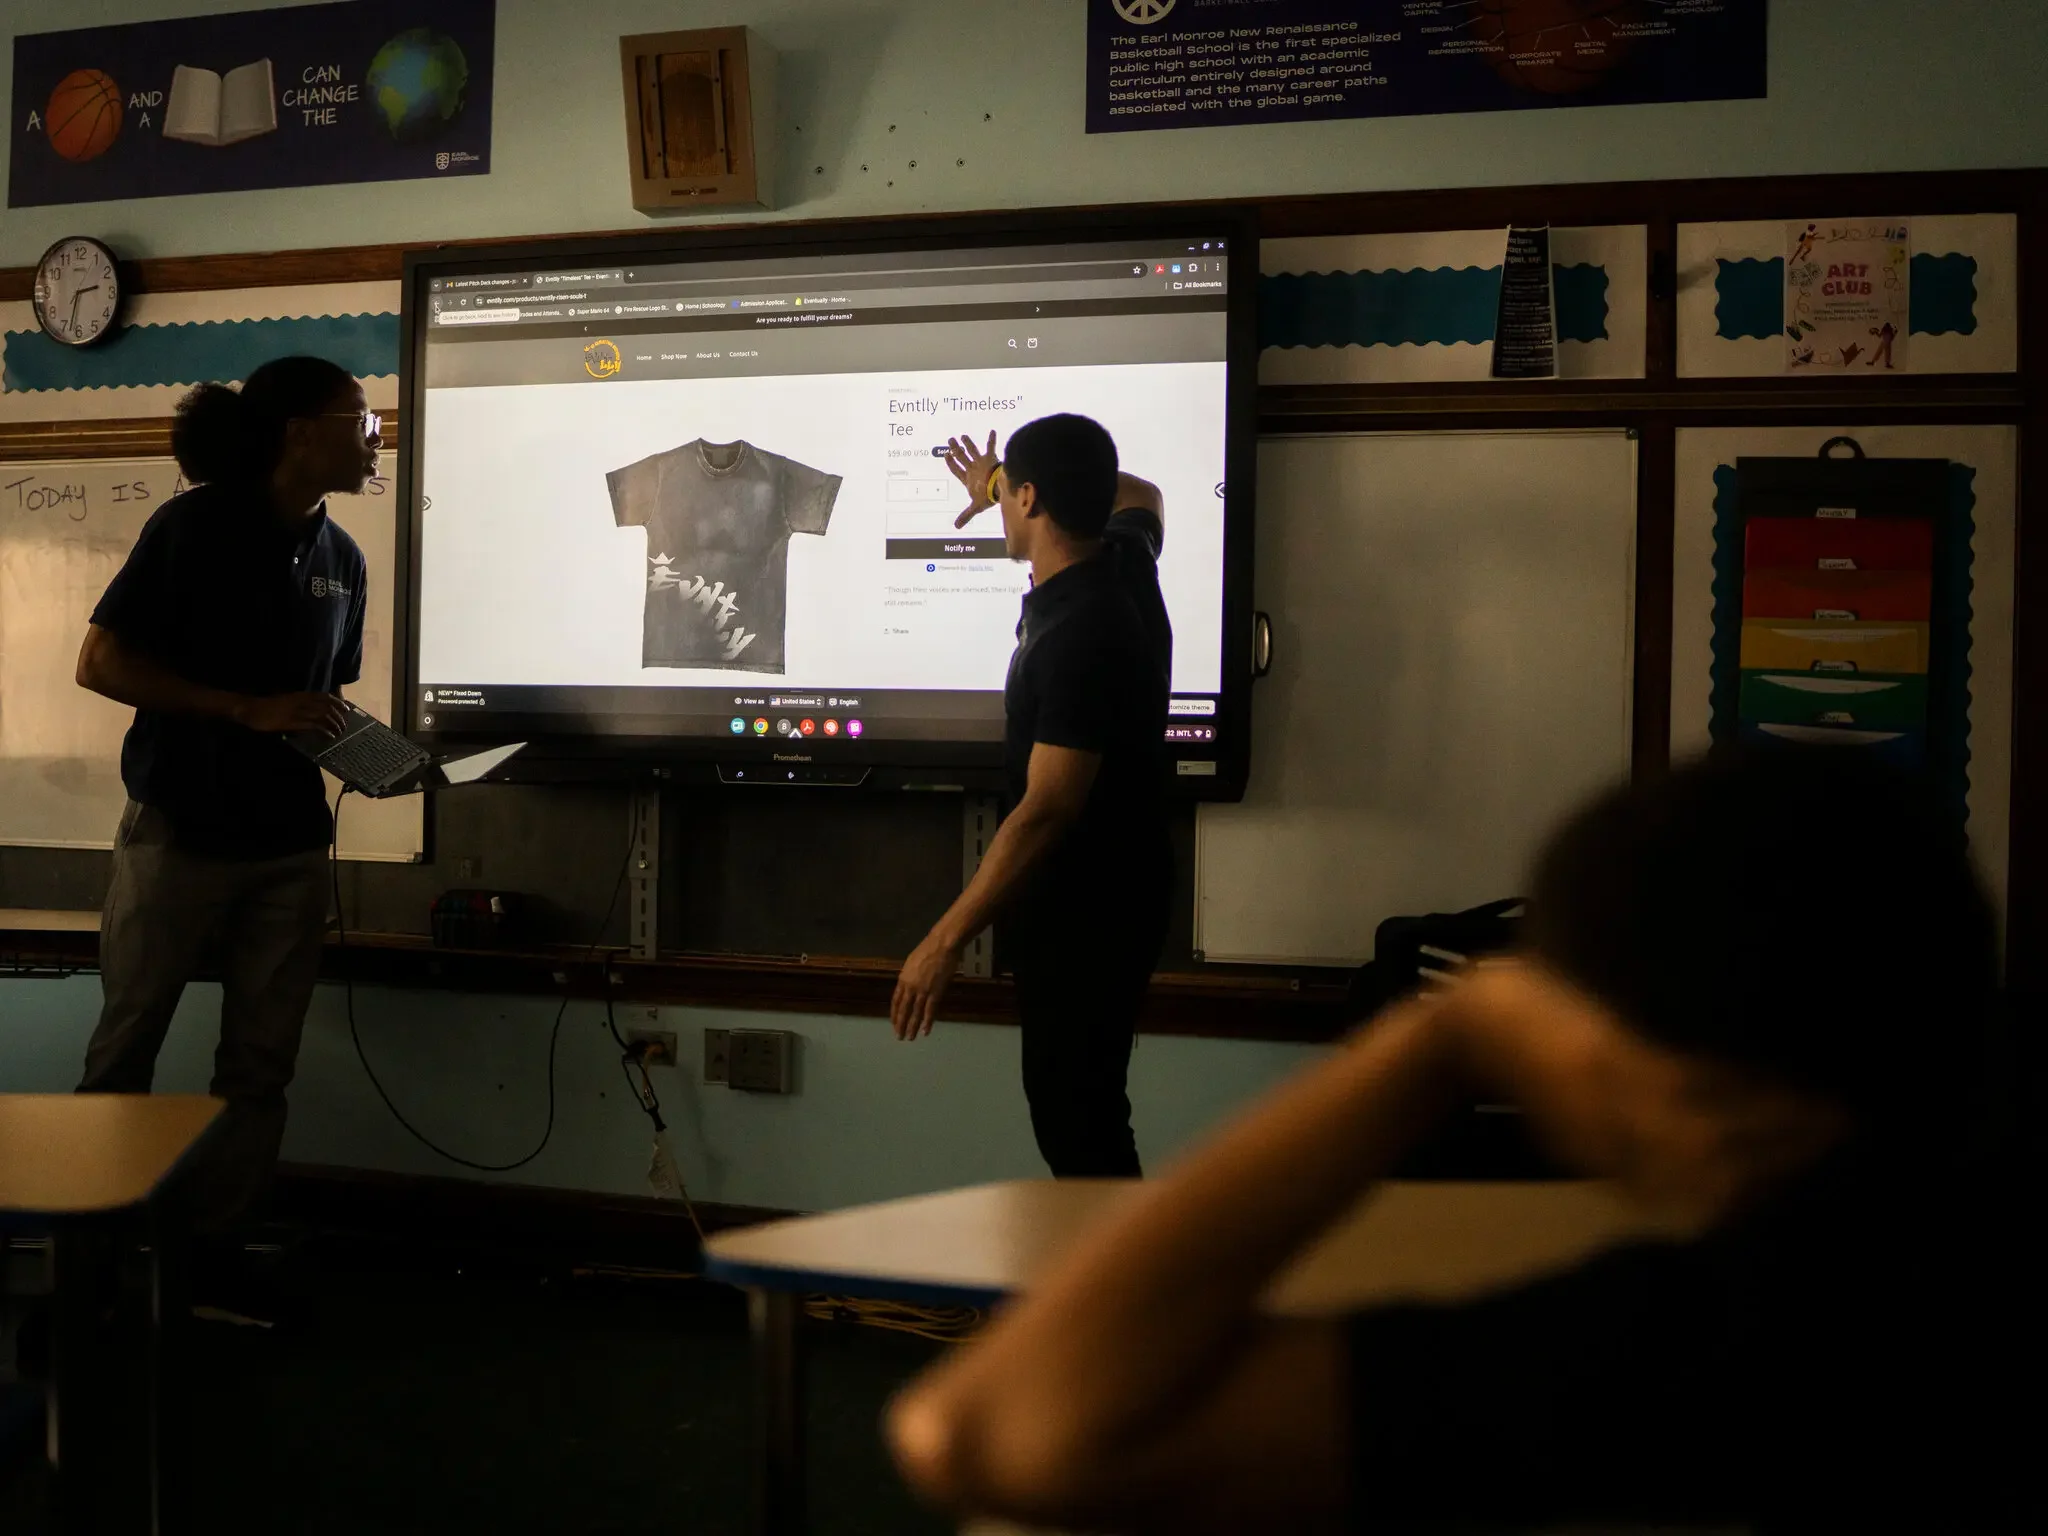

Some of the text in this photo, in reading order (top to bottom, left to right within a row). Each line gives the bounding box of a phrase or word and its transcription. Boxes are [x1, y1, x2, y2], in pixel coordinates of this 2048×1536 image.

[1402, 1, 1443, 10] VENTURE
[1111, 21, 1358, 46] The Earl Monroe New Renaissance
[1612, 28, 1676, 38] MANAGEMENT
[1110, 31, 1401, 60] Basketball School is the first specialized
[1110, 48, 1369, 75] public high school with an academic
[303, 65, 341, 85] CAN
[1110, 62, 1371, 88] curriculum entirely designed around
[1110, 75, 1387, 101] basketball and the many career paths
[129, 91, 163, 109] AND
[283, 84, 359, 107] CHANGE
[1110, 92, 1346, 115] associated with the global game.
[26, 110, 41, 131] A
[139, 112, 151, 129] A
[302, 108, 338, 126] THE
[60, 253, 71, 266] 11
[74, 246, 87, 260] 12
[93, 252, 99, 266] 1
[50, 267, 61, 281] 10
[103, 266, 112, 279] 2
[1826, 263, 1870, 278] ART
[43, 286, 51, 299] 9
[108, 286, 116, 299] 3
[1821, 281, 1872, 297] CLUB
[49, 306, 56, 319] 8
[102, 307, 112, 320] 4
[800, 314, 816, 322] fulfill
[829, 313, 853, 321] dreams?
[60, 320, 68, 333] 7
[75, 325, 82, 338] 6
[91, 320, 98, 333] 5
[889, 395, 1023, 415] Evntlly "Timeless"
[888, 423, 914, 436] Tee
[6, 476, 88, 522] TODAY
[112, 481, 150, 503] IS
[944, 544, 964, 553] Notify
[839, 698, 859, 706] English
[773, 753, 812, 761] Promethean
